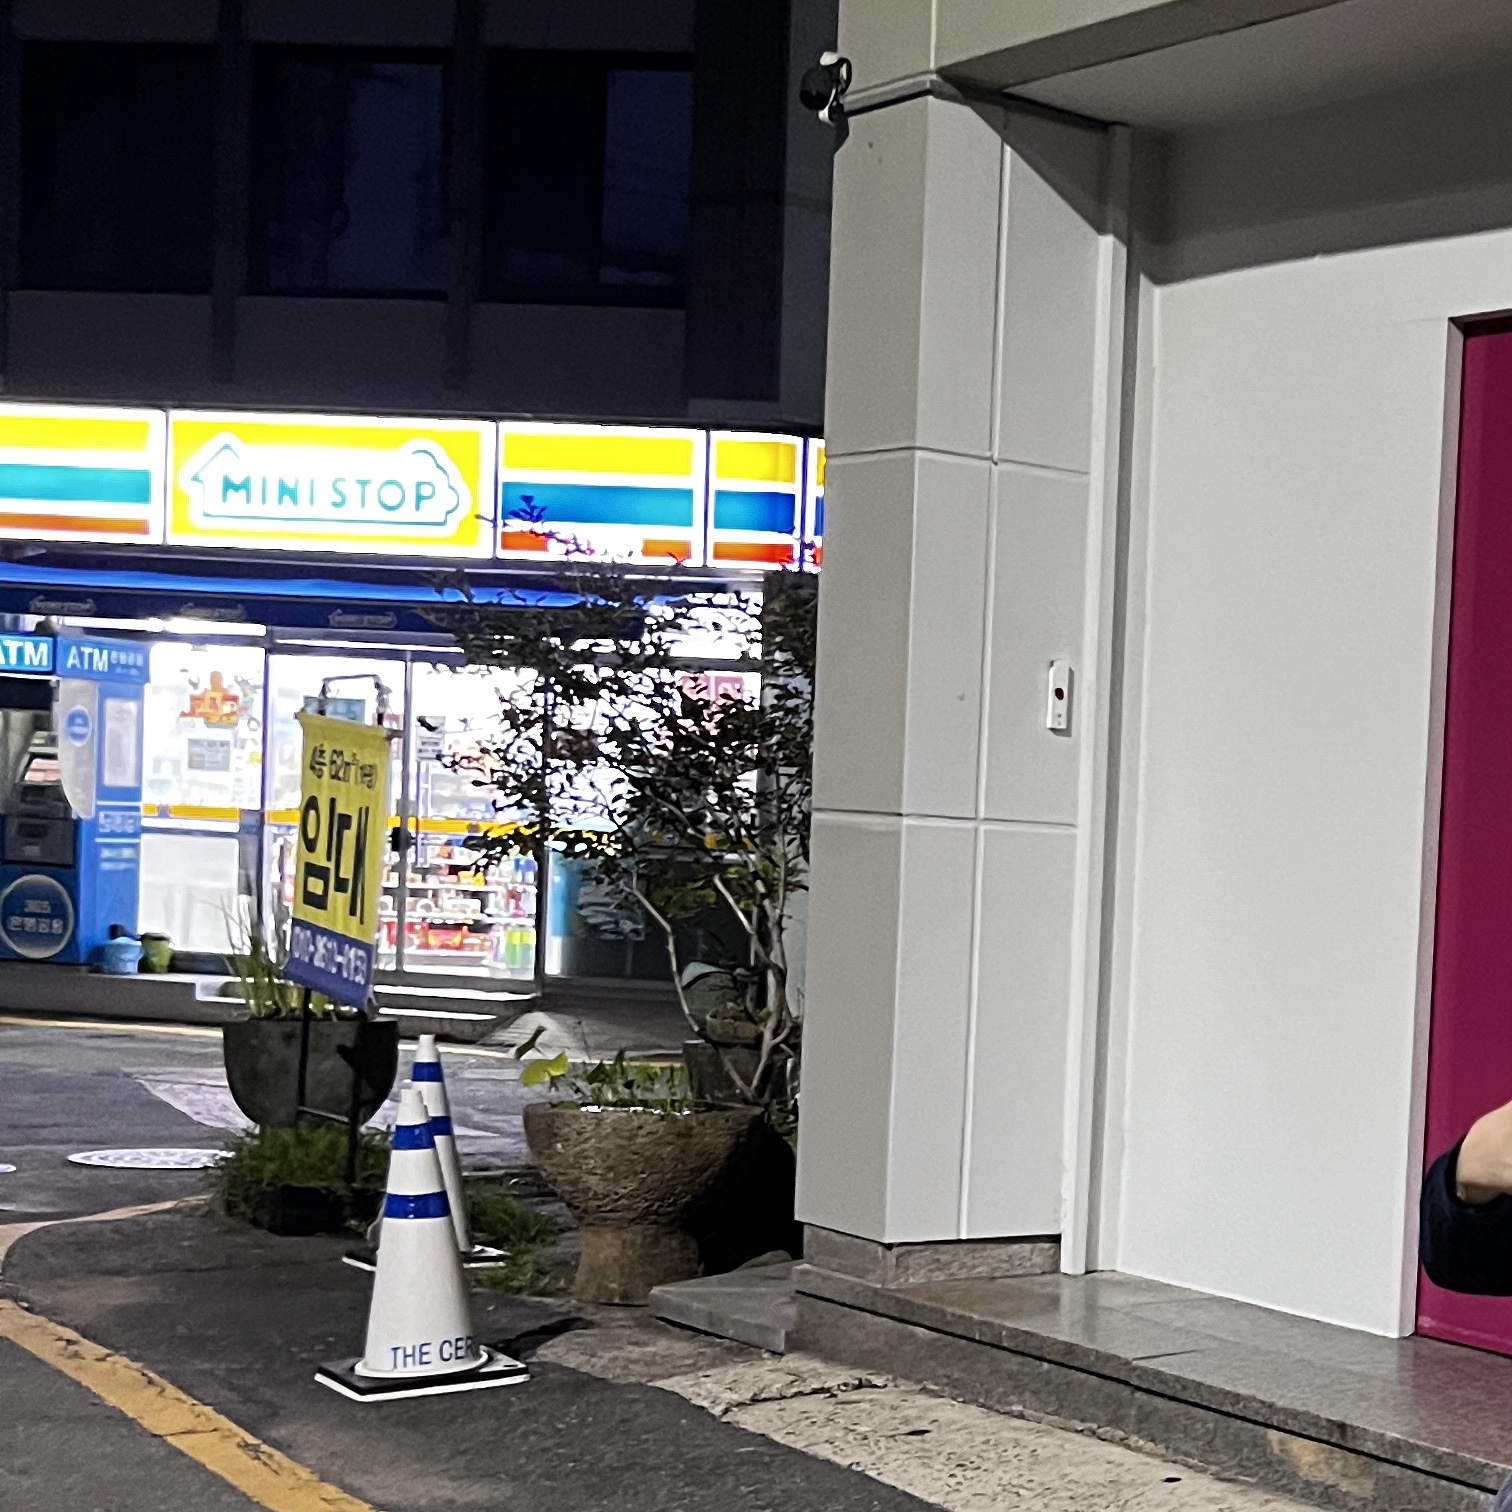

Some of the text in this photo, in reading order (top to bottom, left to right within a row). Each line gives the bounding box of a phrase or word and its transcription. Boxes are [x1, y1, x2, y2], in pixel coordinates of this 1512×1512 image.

[221, 474, 436, 512] MINISTOP
[66, 646, 109, 673] ATM
[301, 794, 371, 926] 임대
[391, 1342, 432, 1369] THE
